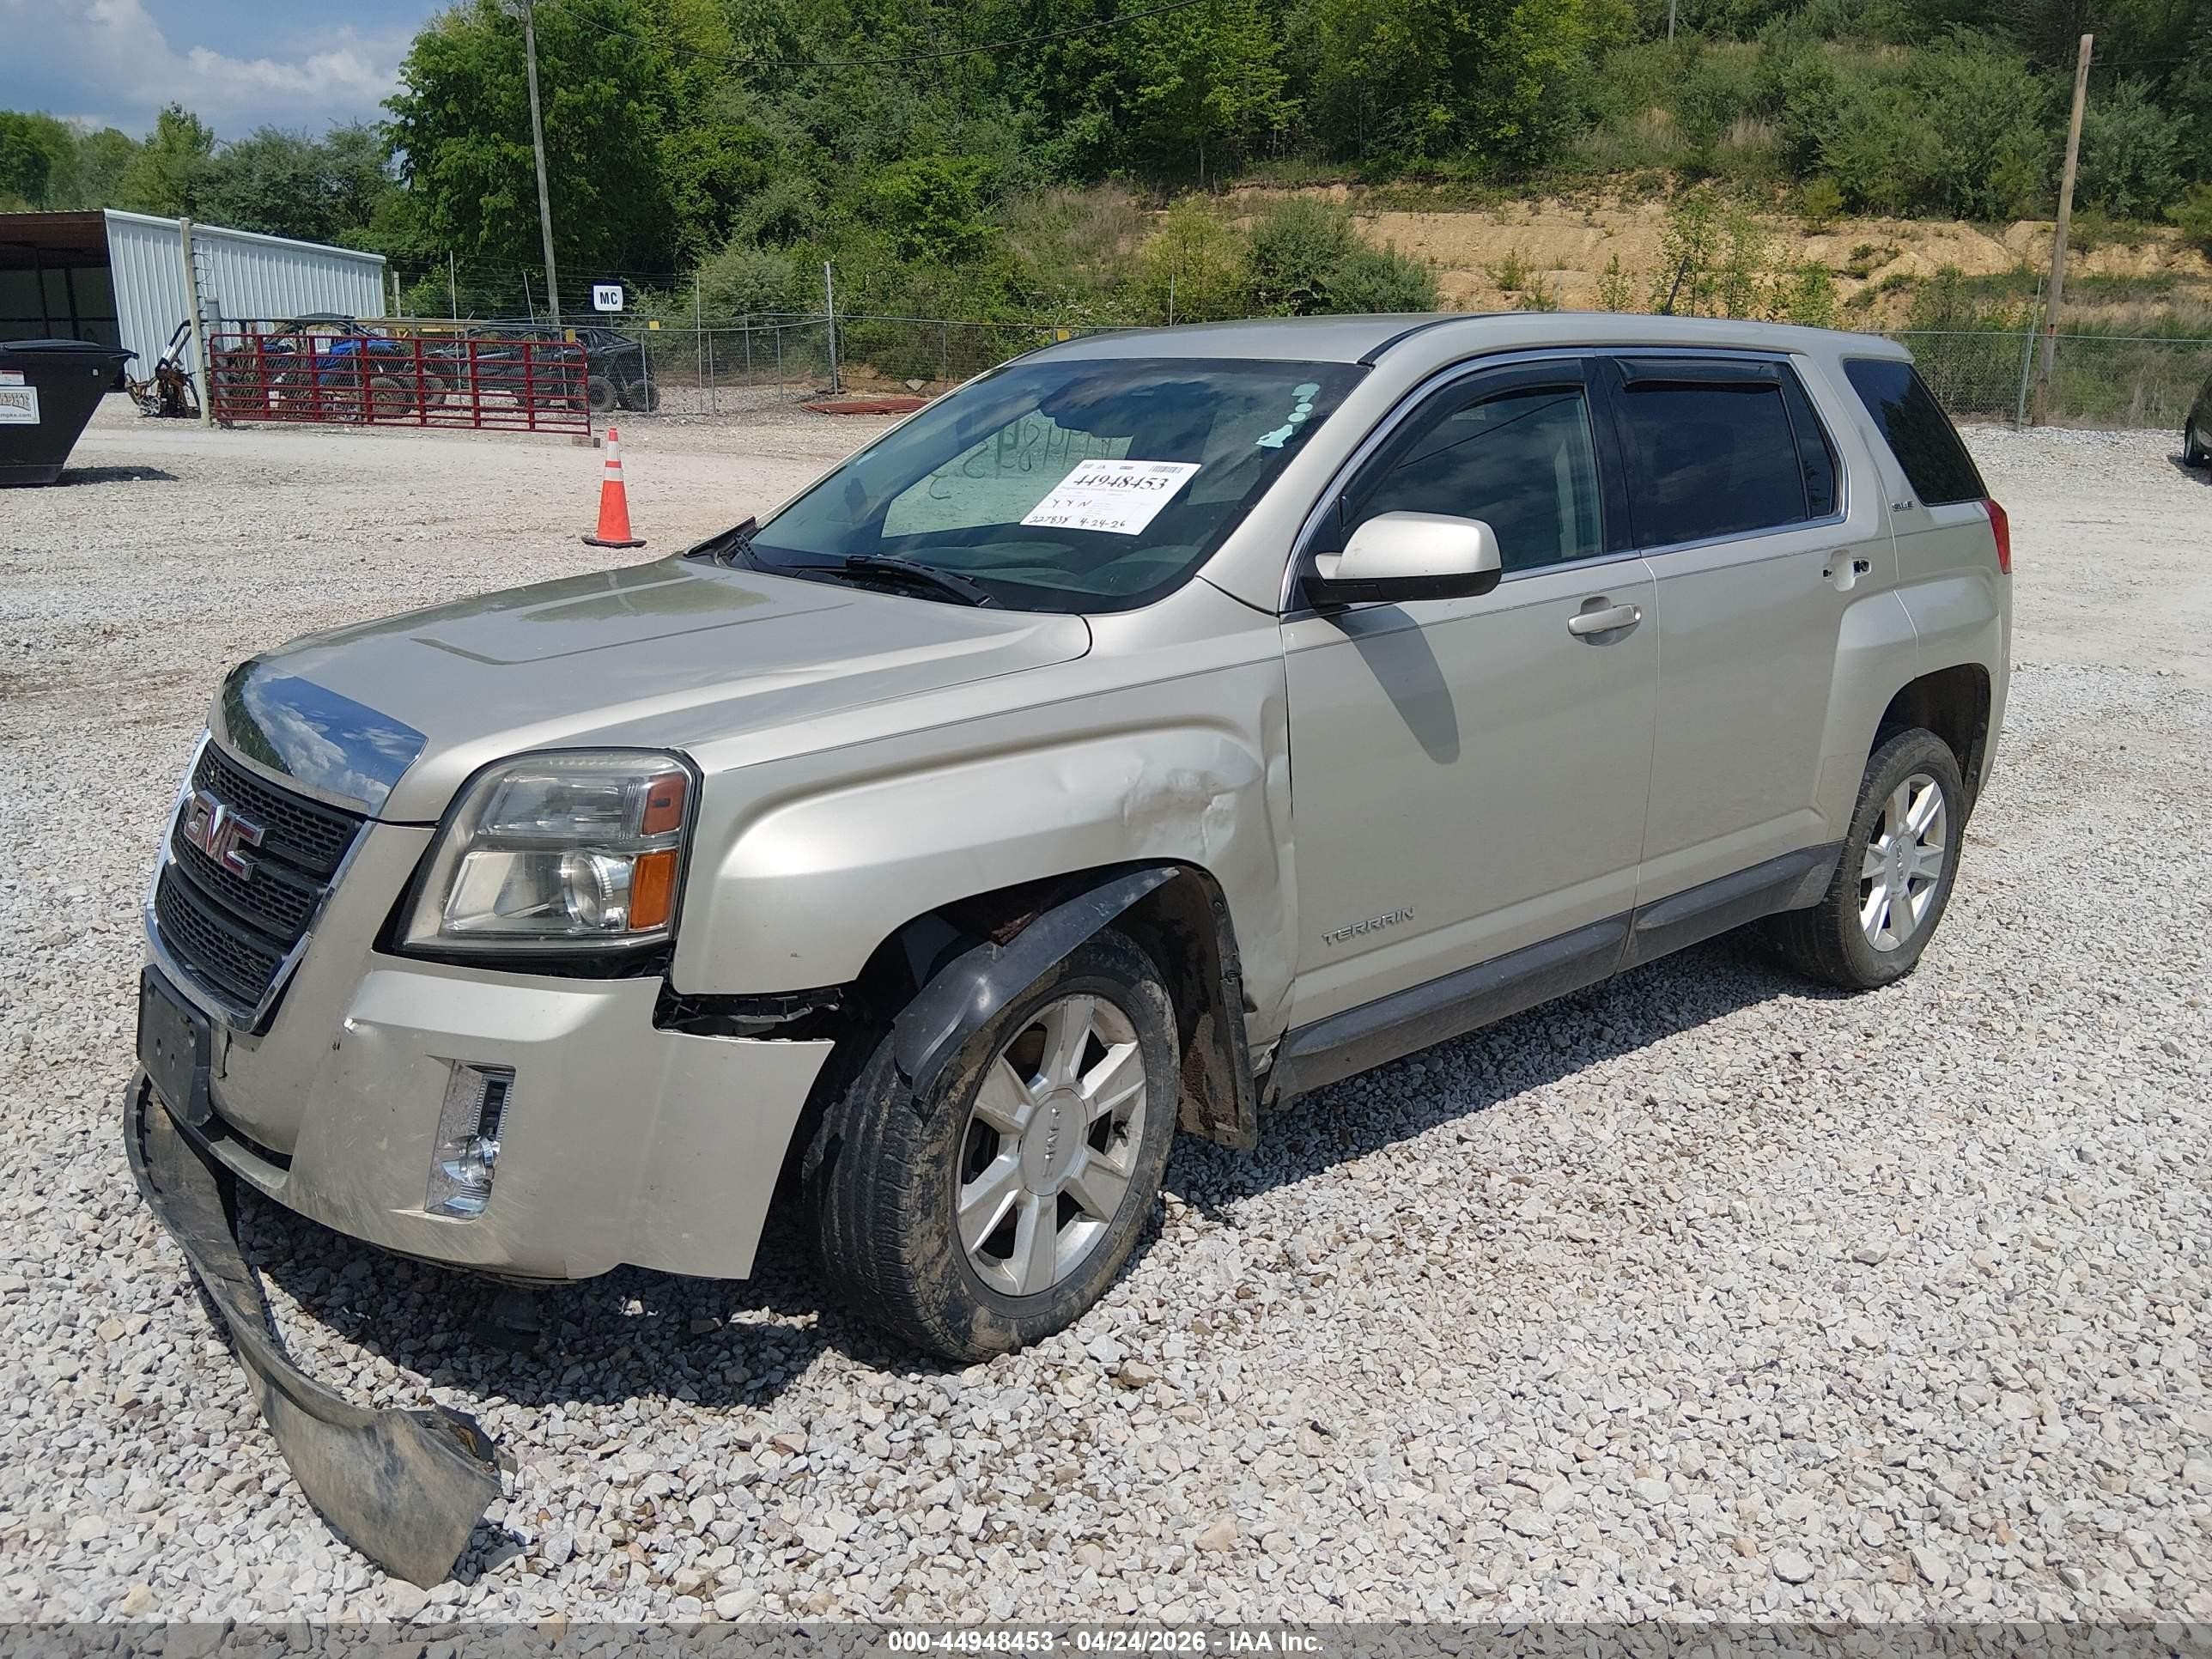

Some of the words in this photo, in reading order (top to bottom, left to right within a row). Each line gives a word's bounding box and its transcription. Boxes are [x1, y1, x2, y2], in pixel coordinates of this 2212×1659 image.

[599, 291, 618, 305] MC
[1073, 474, 1170, 491] 44948453
[1079, 517, 1127, 529] 4-24-26
[184, 790, 265, 881] GMC
[1322, 906, 1415, 945] TERRAIN
